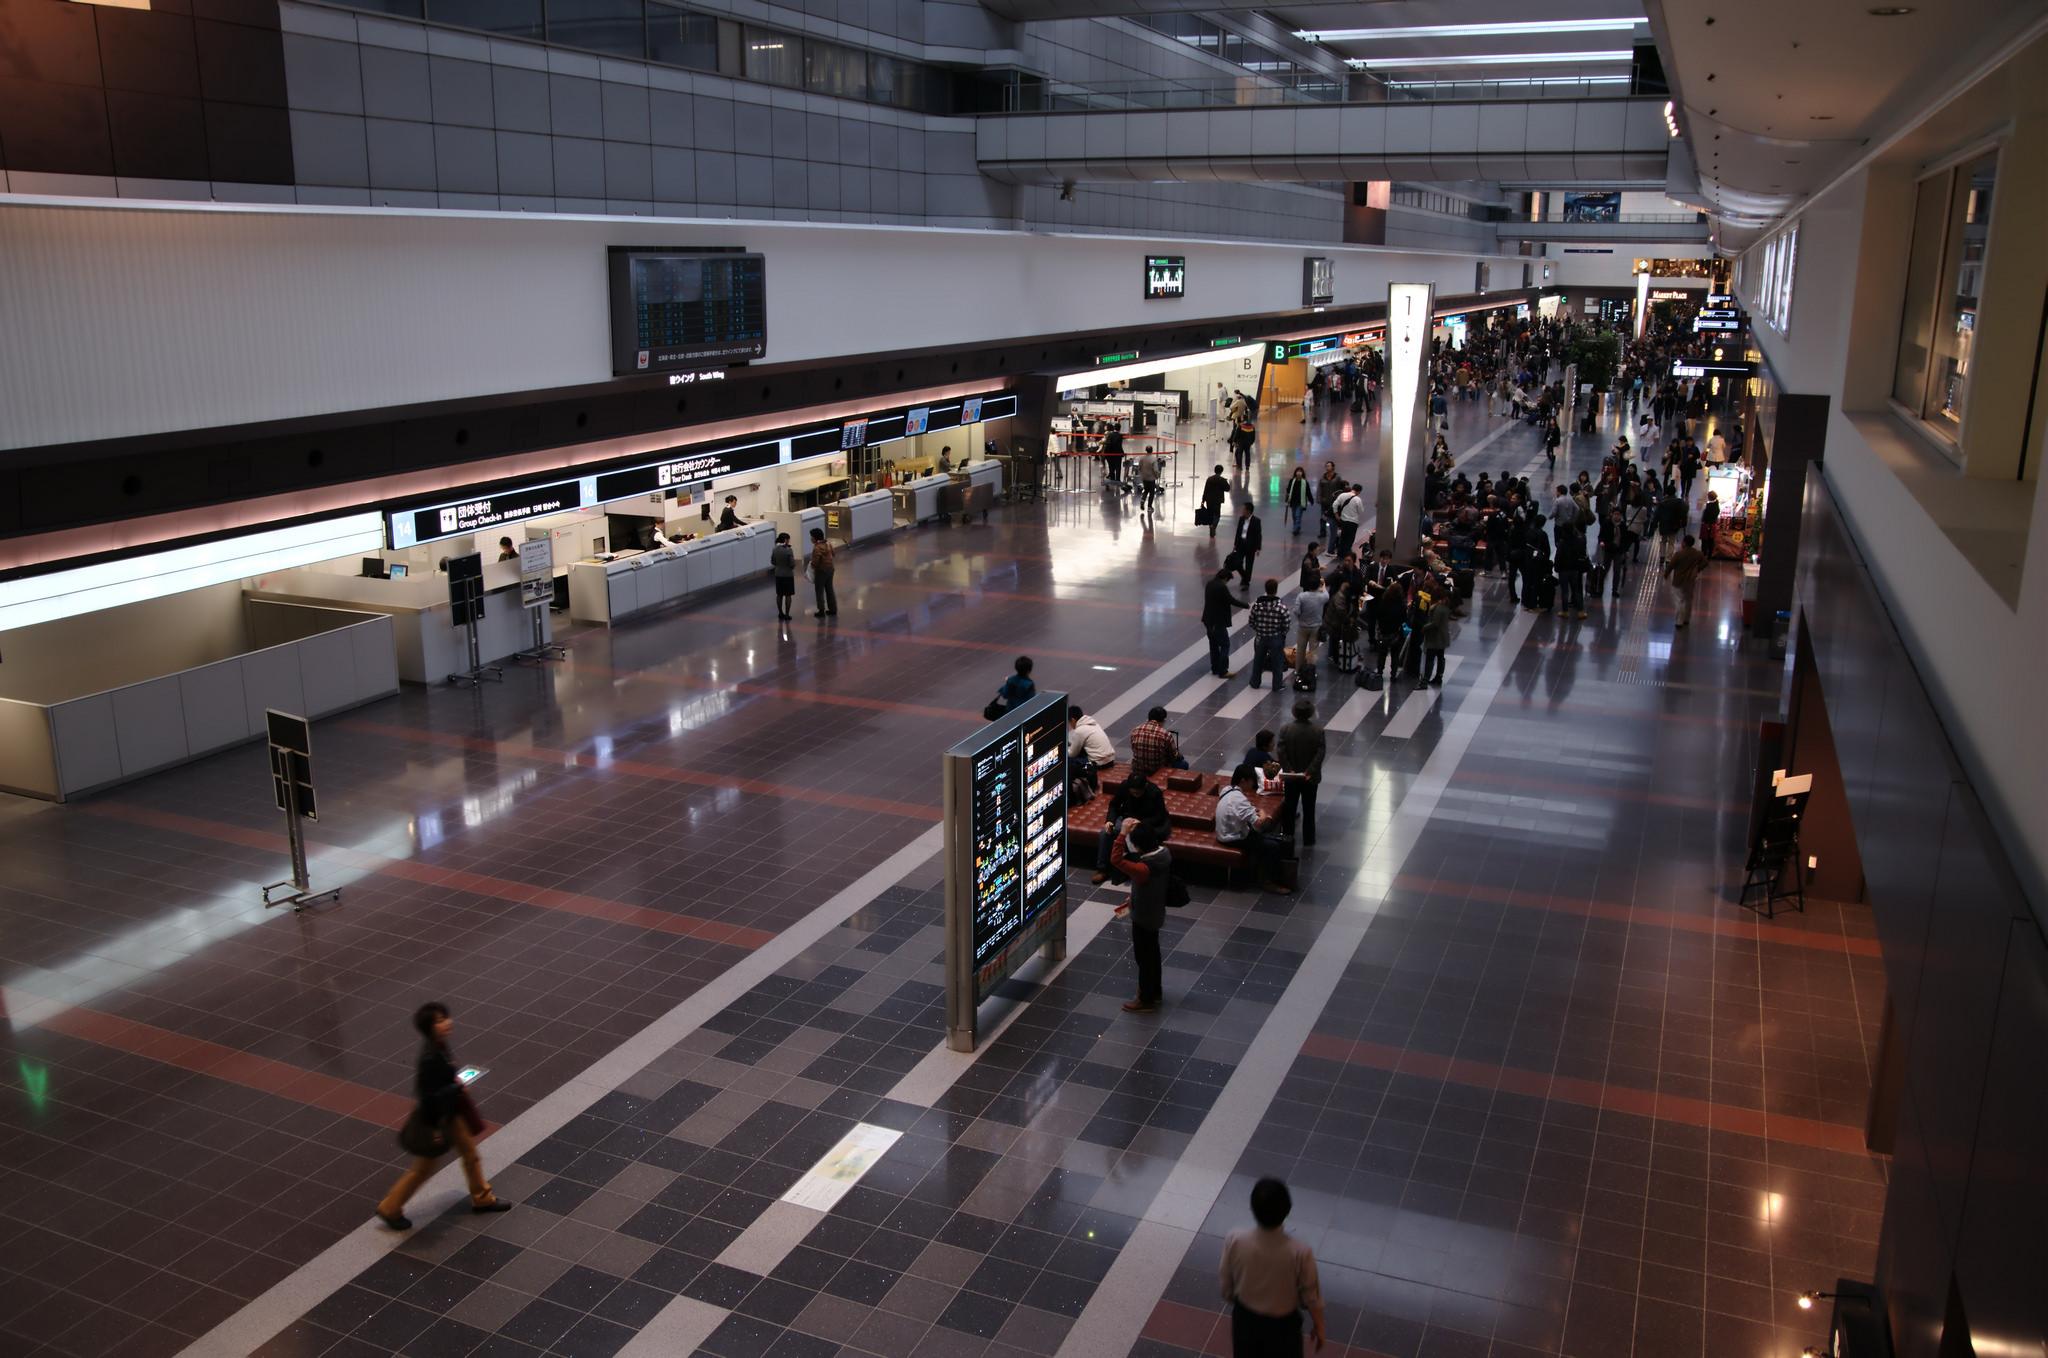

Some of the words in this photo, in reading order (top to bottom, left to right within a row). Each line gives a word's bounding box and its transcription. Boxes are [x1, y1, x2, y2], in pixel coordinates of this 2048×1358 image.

[1673, 291, 1687, 299] PLACE
[1275, 346, 1284, 359] B
[1244, 358, 1252, 370] B
[671, 457, 720, 474] 旅行会社カウンター
[682, 473, 692, 481] Desk
[584, 484, 593, 497] 16
[458, 500, 491, 518] 団体受付
[459, 520, 477, 528] Group
[478, 514, 502, 525] Check-in
[397, 520, 412, 537] 14
